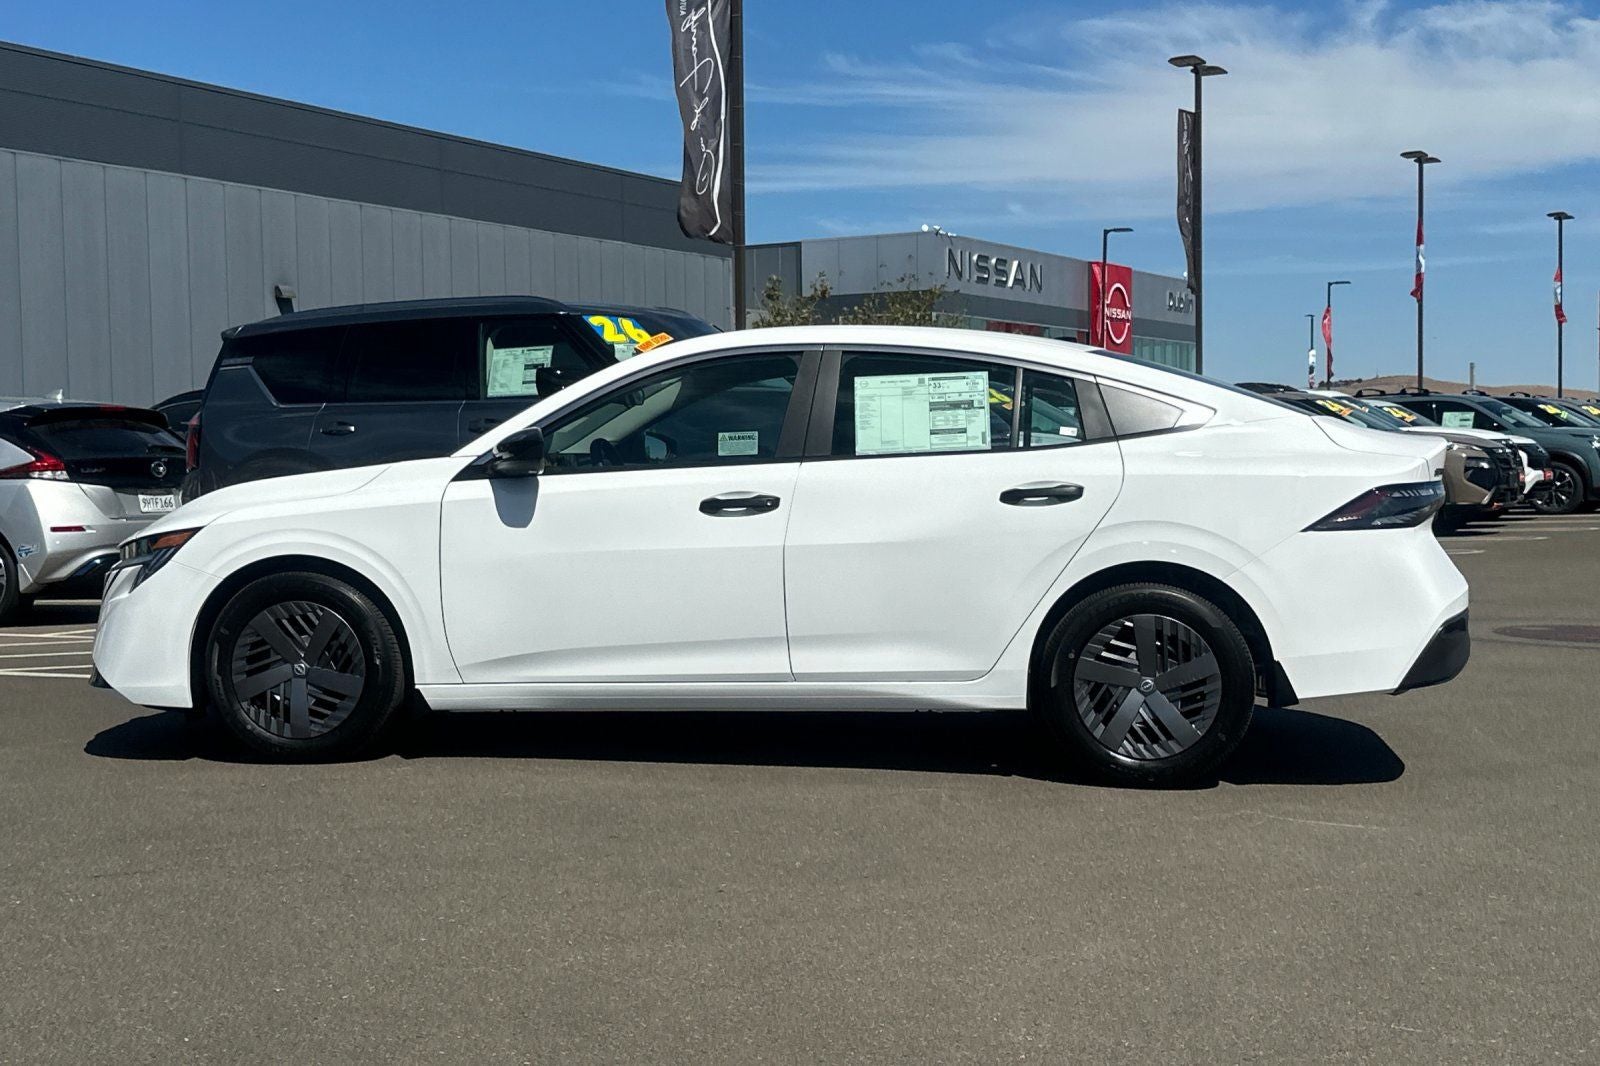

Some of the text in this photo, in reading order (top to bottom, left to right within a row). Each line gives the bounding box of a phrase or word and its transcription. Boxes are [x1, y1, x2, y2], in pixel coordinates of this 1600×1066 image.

[945, 247, 1043, 293] NISSAN
[1104, 306, 1132, 320] NISSAN
[588, 315, 652, 343] 26
